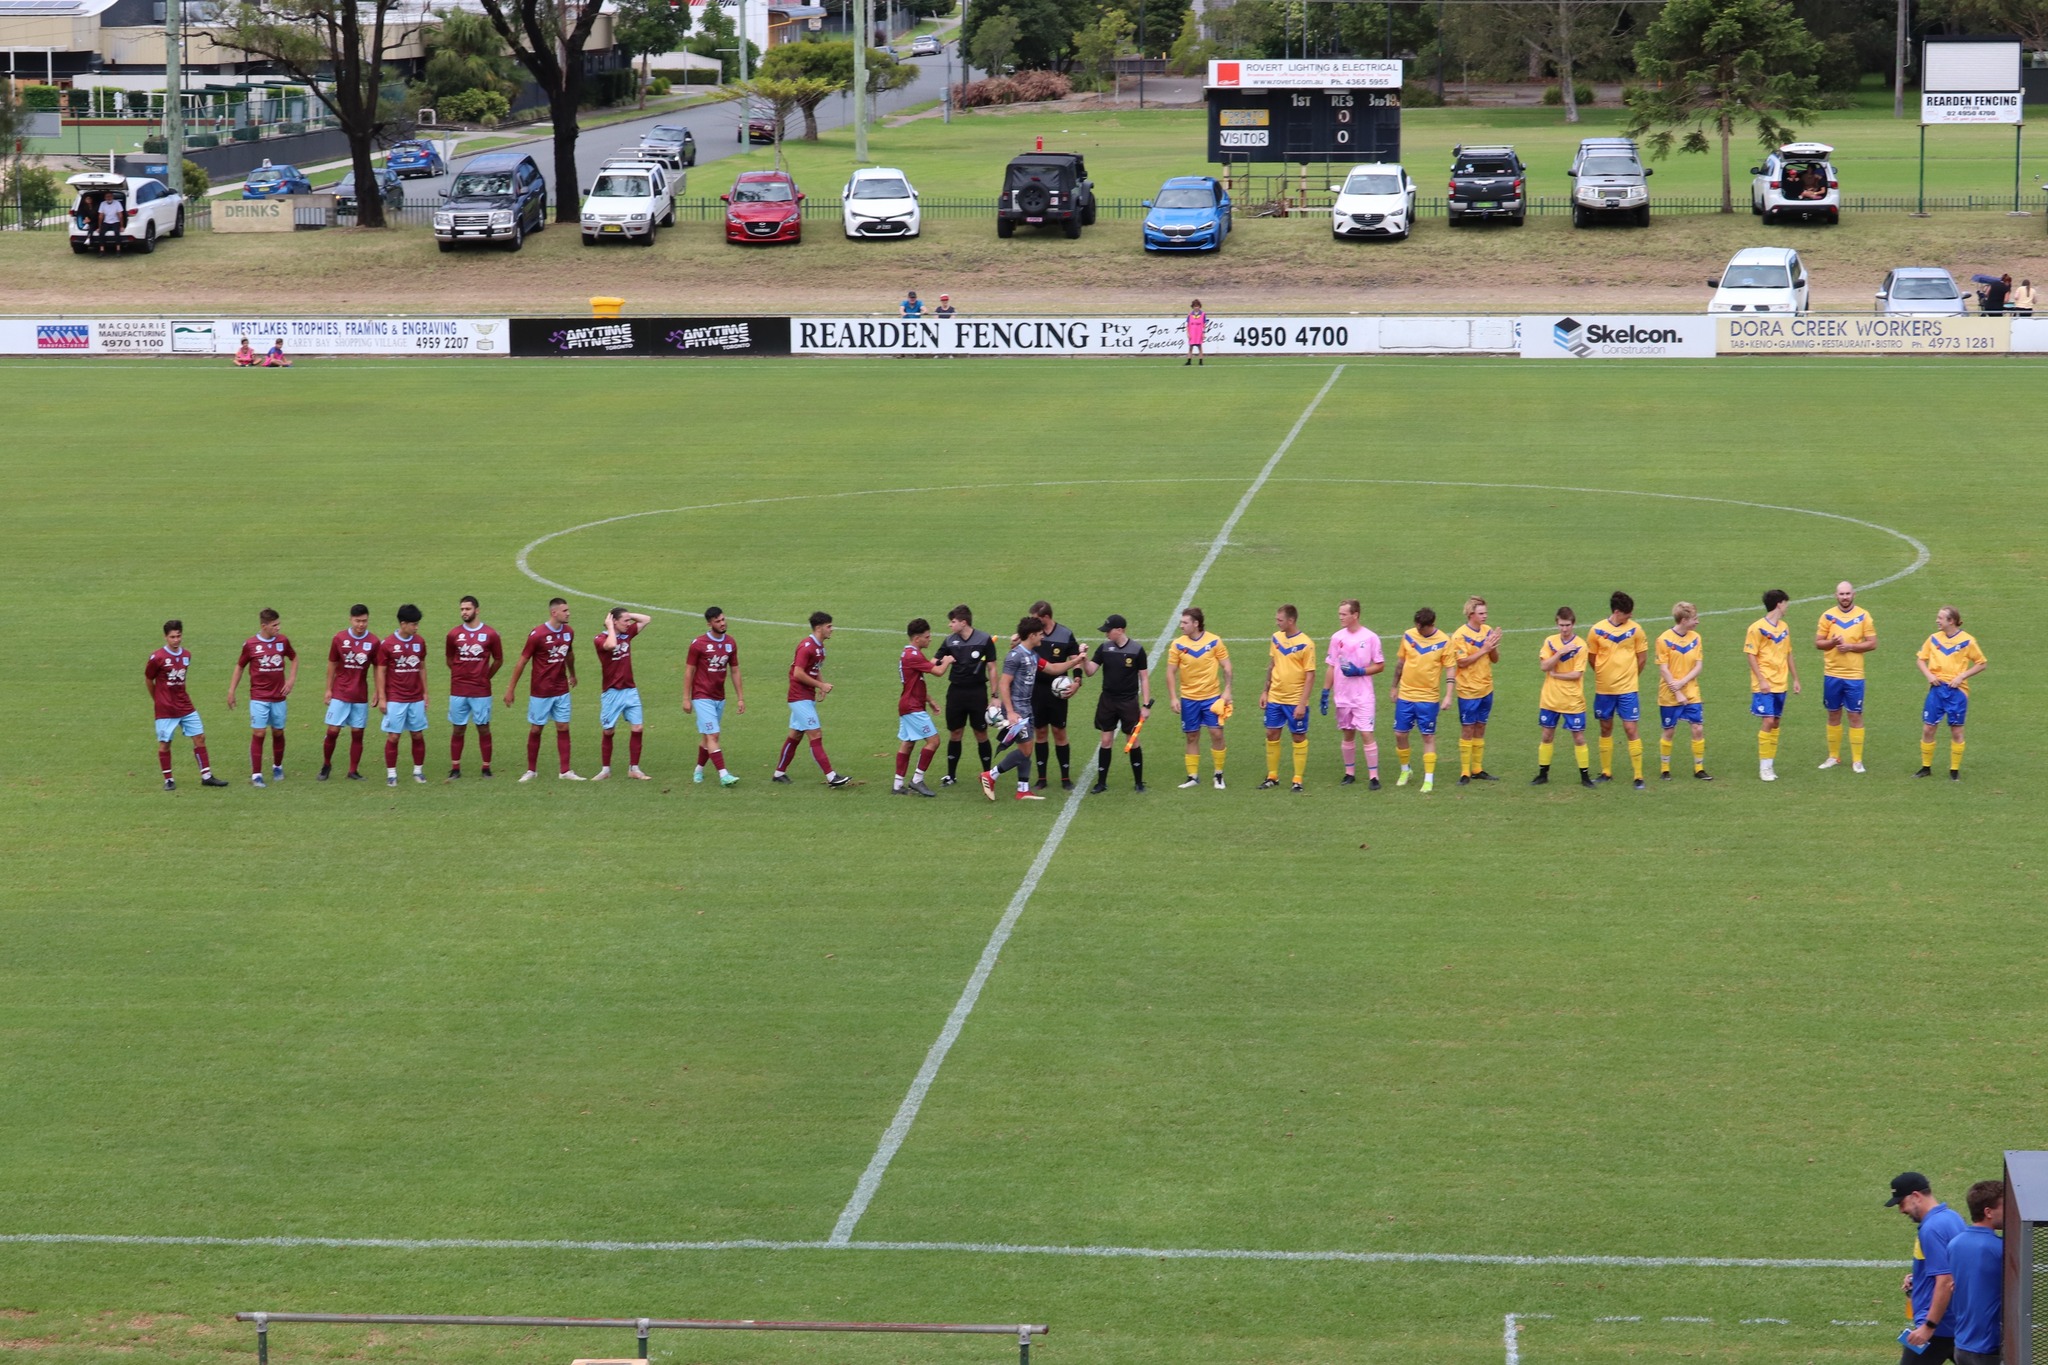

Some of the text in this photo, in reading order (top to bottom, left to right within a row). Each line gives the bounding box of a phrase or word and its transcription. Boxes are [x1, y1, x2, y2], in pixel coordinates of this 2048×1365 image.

[1246, 63, 1399, 72] ROVERT LIGHTING & ELECTRICAL
[1253, 78, 1324, 86] www.rovert.com.au
[1330, 78, 1389, 86] Ph. 4365 5955
[1331, 95, 1354, 107] RES
[1926, 96, 2018, 107] REARDEN FENCING
[1220, 132, 1267, 145] VISITOR
[1337, 130, 1349, 144] 0
[225, 205, 280, 218] DRINKS
[98, 322, 166, 330] MACQUARIE
[231, 321, 457, 338] WESTLAKES TROPHIES, FRAMING & ENGRAVING
[565, 323, 632, 340] ANYTIME
[682, 322, 749, 340] ANYTIME
[1101, 322, 1132, 336] Pty
[1146, 325, 1170, 338] For
[1730, 320, 1943, 337] DORA CREEK WORKERS
[800, 321, 1089, 349] REARDEN FENCING
[1233, 326, 1349, 347] 4950 4700
[1586, 323, 1683, 344] Skelcon.
[101, 339, 164, 347] 4970 1100
[287, 337, 312, 348] CAREY
[315, 337, 331, 348] BAY
[334, 337, 373, 348] SHOPPING
[374, 337, 408, 348] VILLAGE
[415, 337, 469, 349] 4959 2207
[567, 335, 634, 349] FITNESS
[605, 343, 633, 351] TORONTO
[684, 335, 751, 348] FITNESS
[722, 342, 751, 350] TORONTO
[1100, 336, 1134, 348] Ltd
[1138, 338, 1185, 352] Fencing
[1928, 337, 1960, 349] 4973
[1965, 337, 1995, 349] 1281
[1601, 343, 1666, 354] Construction
